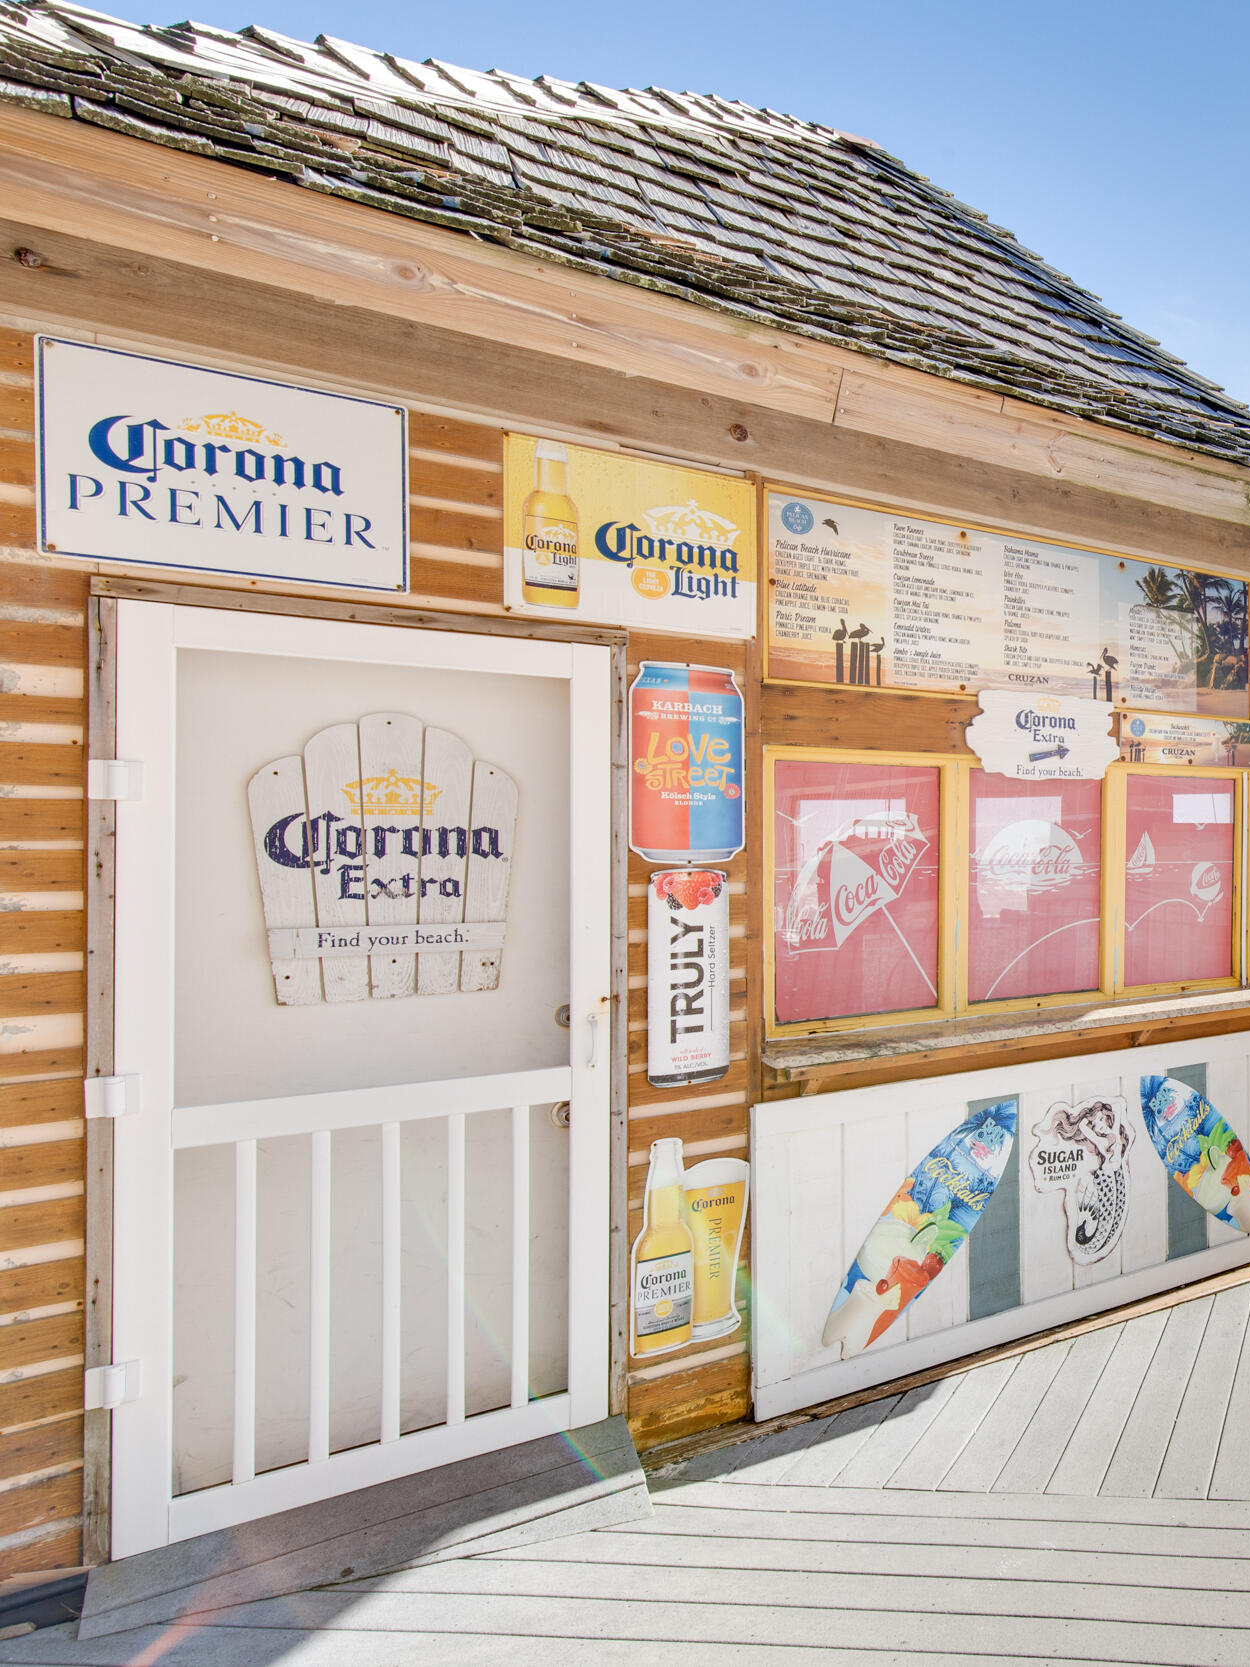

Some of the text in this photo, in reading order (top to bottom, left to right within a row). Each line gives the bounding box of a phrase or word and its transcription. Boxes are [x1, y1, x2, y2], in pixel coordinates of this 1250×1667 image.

[88, 415, 345, 496] Corona
[67, 473, 377, 549] PREMIER
[526, 533, 576, 553] Corona
[595, 521, 740, 573] Corona
[776, 539, 851, 560] Pelican Beach Hurricane
[670, 565, 740, 601] Light
[776, 579, 817, 592] Blue Latitude
[795, 613, 816, 623] Dream
[1008, 673, 1049, 684] CRUZAN
[652, 700, 723, 714] KARBACH
[661, 712, 704, 722] BREWING
[1015, 709, 1076, 732] Corona
[1033, 729, 1064, 743] Extra
[1162, 748, 1196, 756] CRUZAN
[1016, 764, 1035, 775] Find
[1039, 767, 1056, 778] your
[264, 810, 504, 875] Corona
[337, 864, 462, 900] Extra
[317, 932, 360, 948] Find
[368, 933, 409, 951] your
[708, 925, 716, 988] Hard Seltzer
[670, 916, 704, 1044] TRULY
[1166, 1099, 1210, 1163] Cocktails
[1037, 1149, 1084, 1165] SUGAR
[1043, 1163, 1077, 1175] ISLAND
[923, 1157, 989, 1212] Cocktails
[691, 1196, 735, 1212] Corona
[709, 1217, 722, 1280] PREMIER
[641, 1269, 687, 1290] Corona
[638, 1280, 692, 1301] PREMIER
